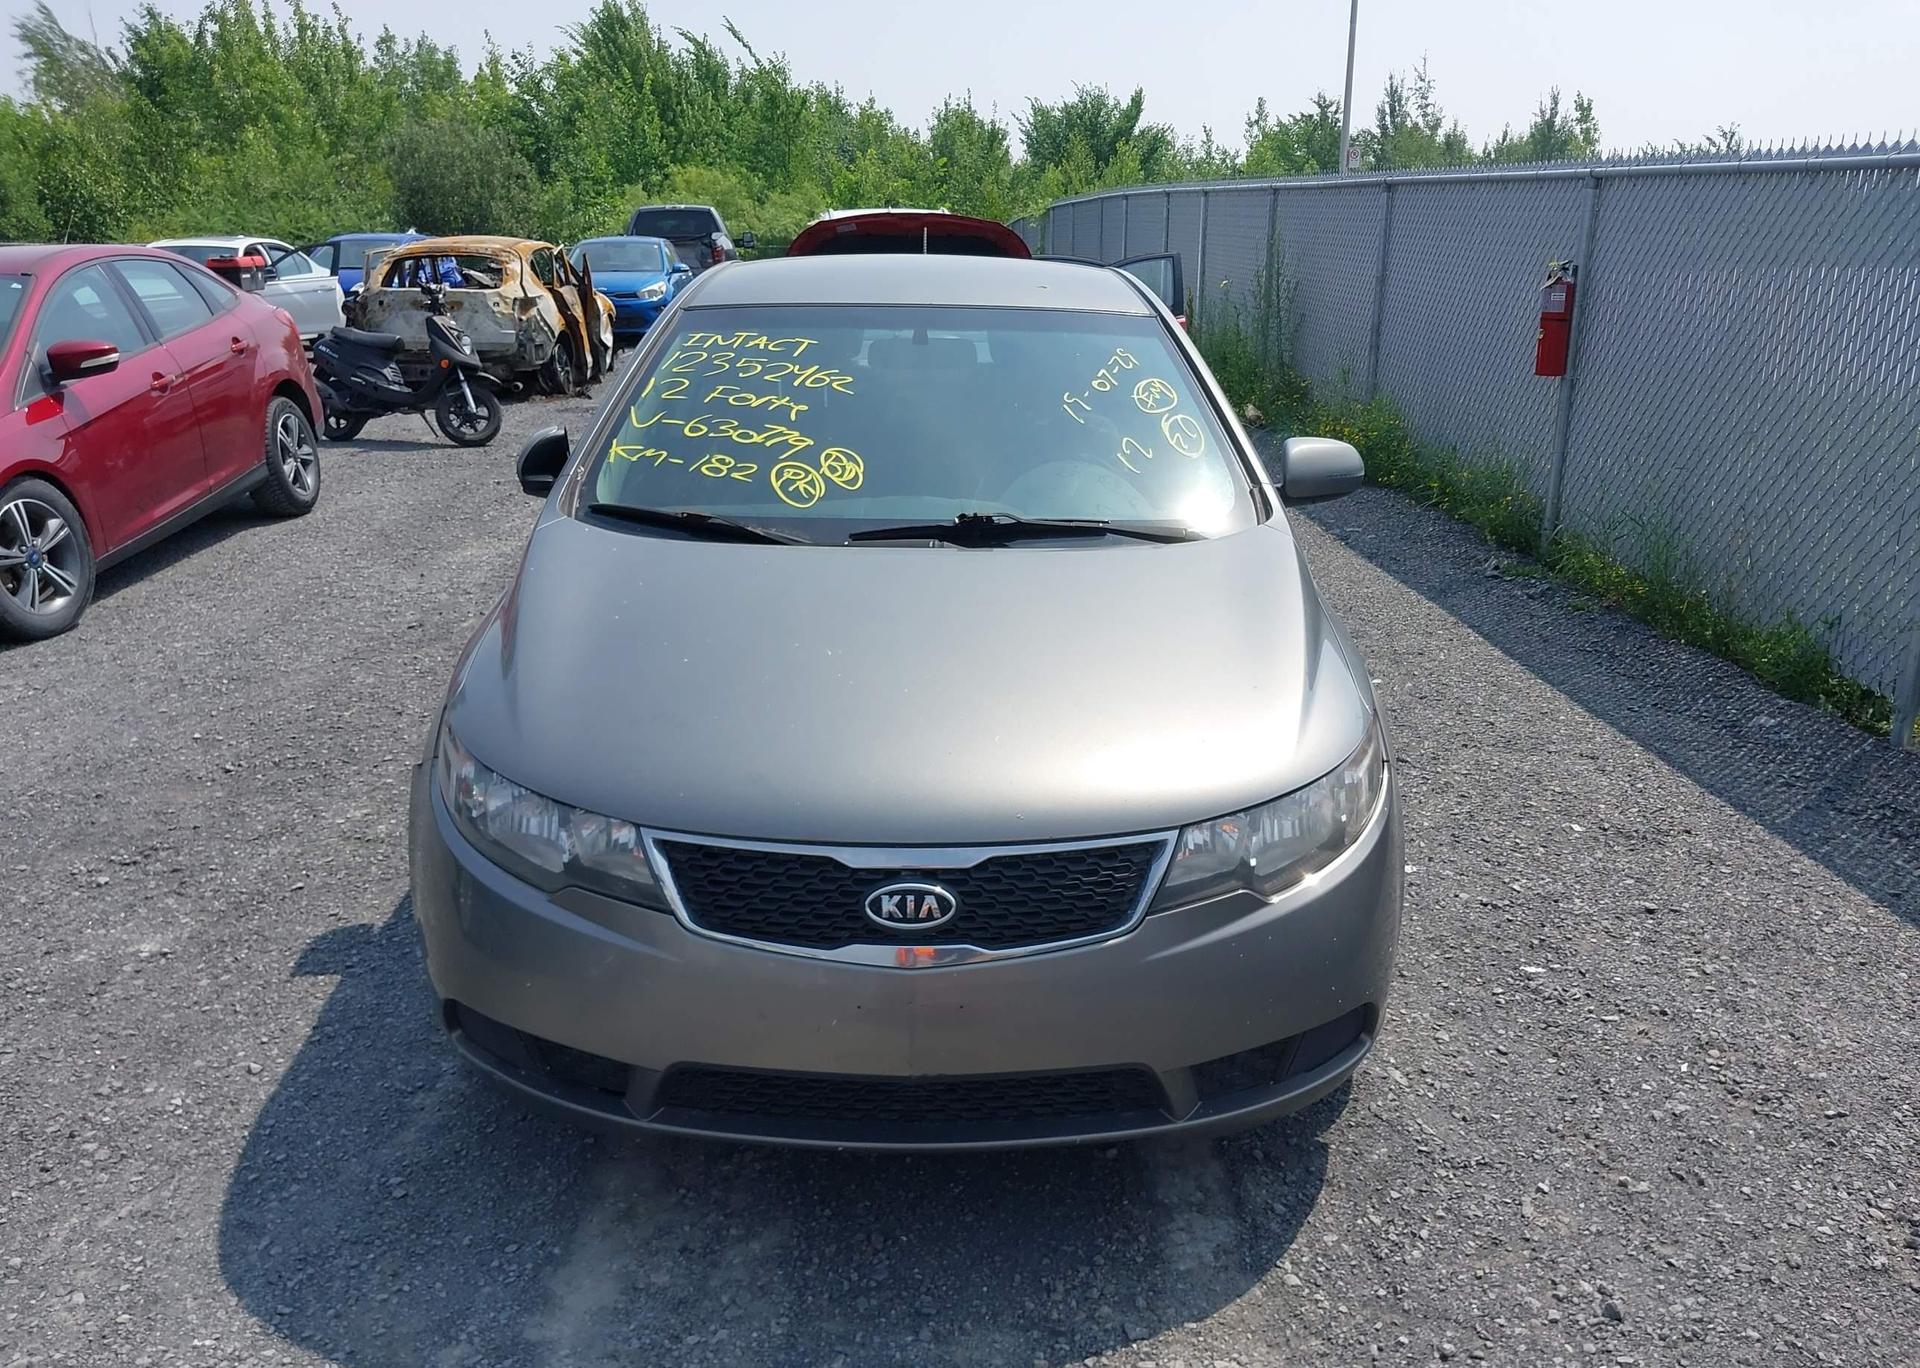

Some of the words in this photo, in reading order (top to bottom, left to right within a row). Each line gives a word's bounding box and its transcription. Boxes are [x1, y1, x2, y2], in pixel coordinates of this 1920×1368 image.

[683, 332, 818, 357] INTACT
[662, 351, 854, 394] 12352462
[642, 378, 690, 399] 12
[881, 894, 942, 919] KIA
